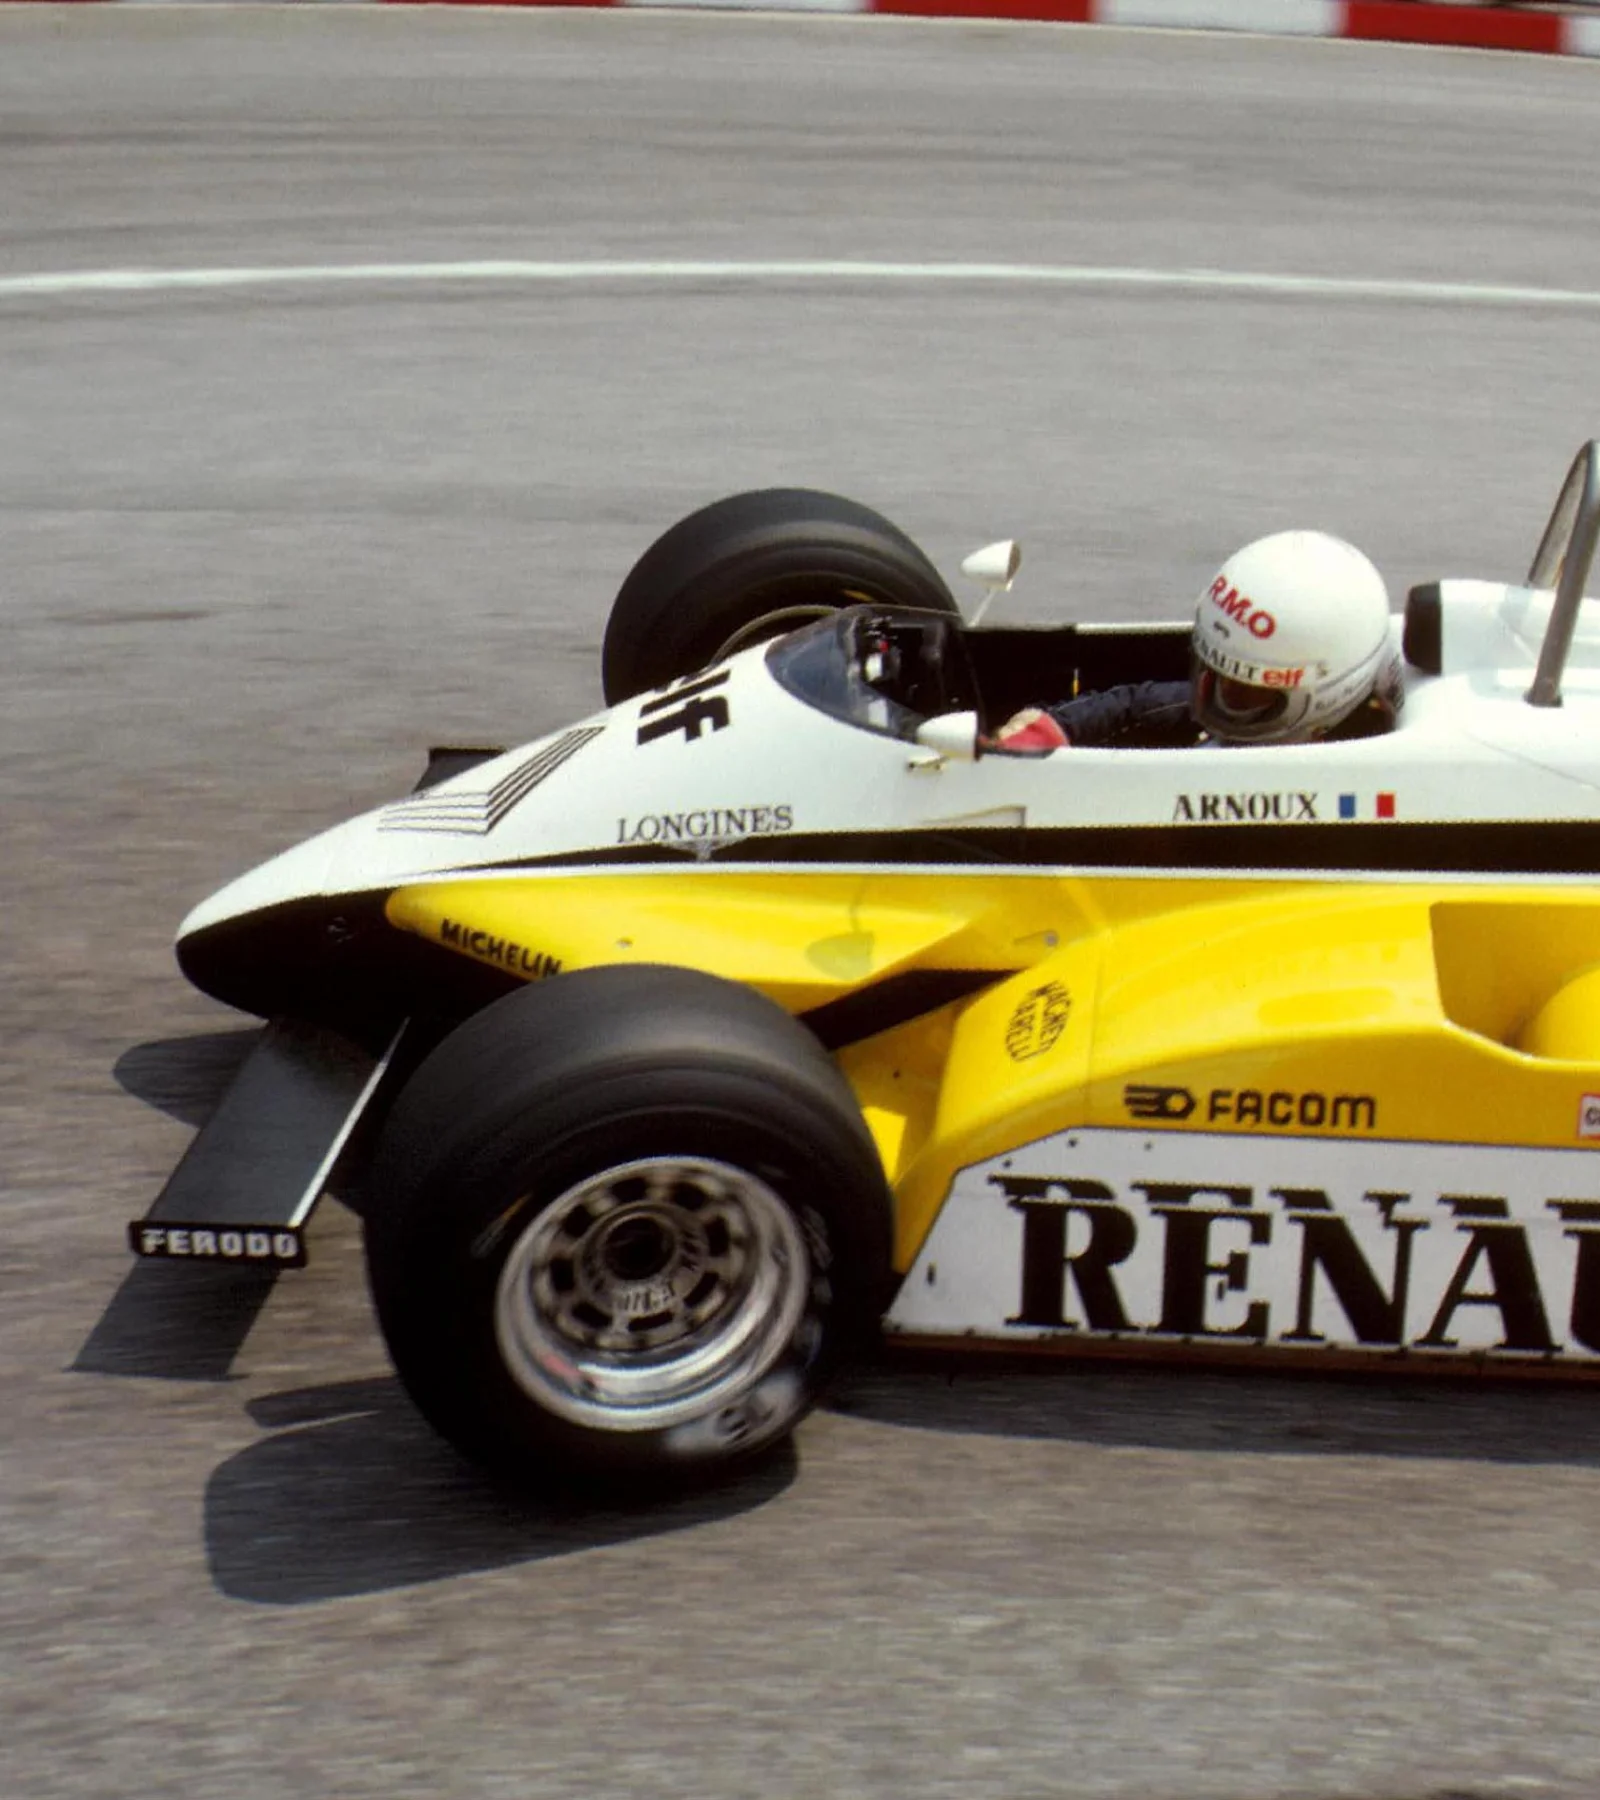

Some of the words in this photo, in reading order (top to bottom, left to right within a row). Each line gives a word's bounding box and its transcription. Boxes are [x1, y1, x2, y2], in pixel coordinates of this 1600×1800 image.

[1261, 667, 1305, 688] elf
[637, 665, 731, 746] lf
[617, 804, 794, 844] LONGINES
[1172, 793, 1319, 821] ARNOUX
[441, 917, 562, 978] MICHELIN
[1208, 1089, 1376, 1128] FACOM
[141, 1228, 298, 1258] FERODO
